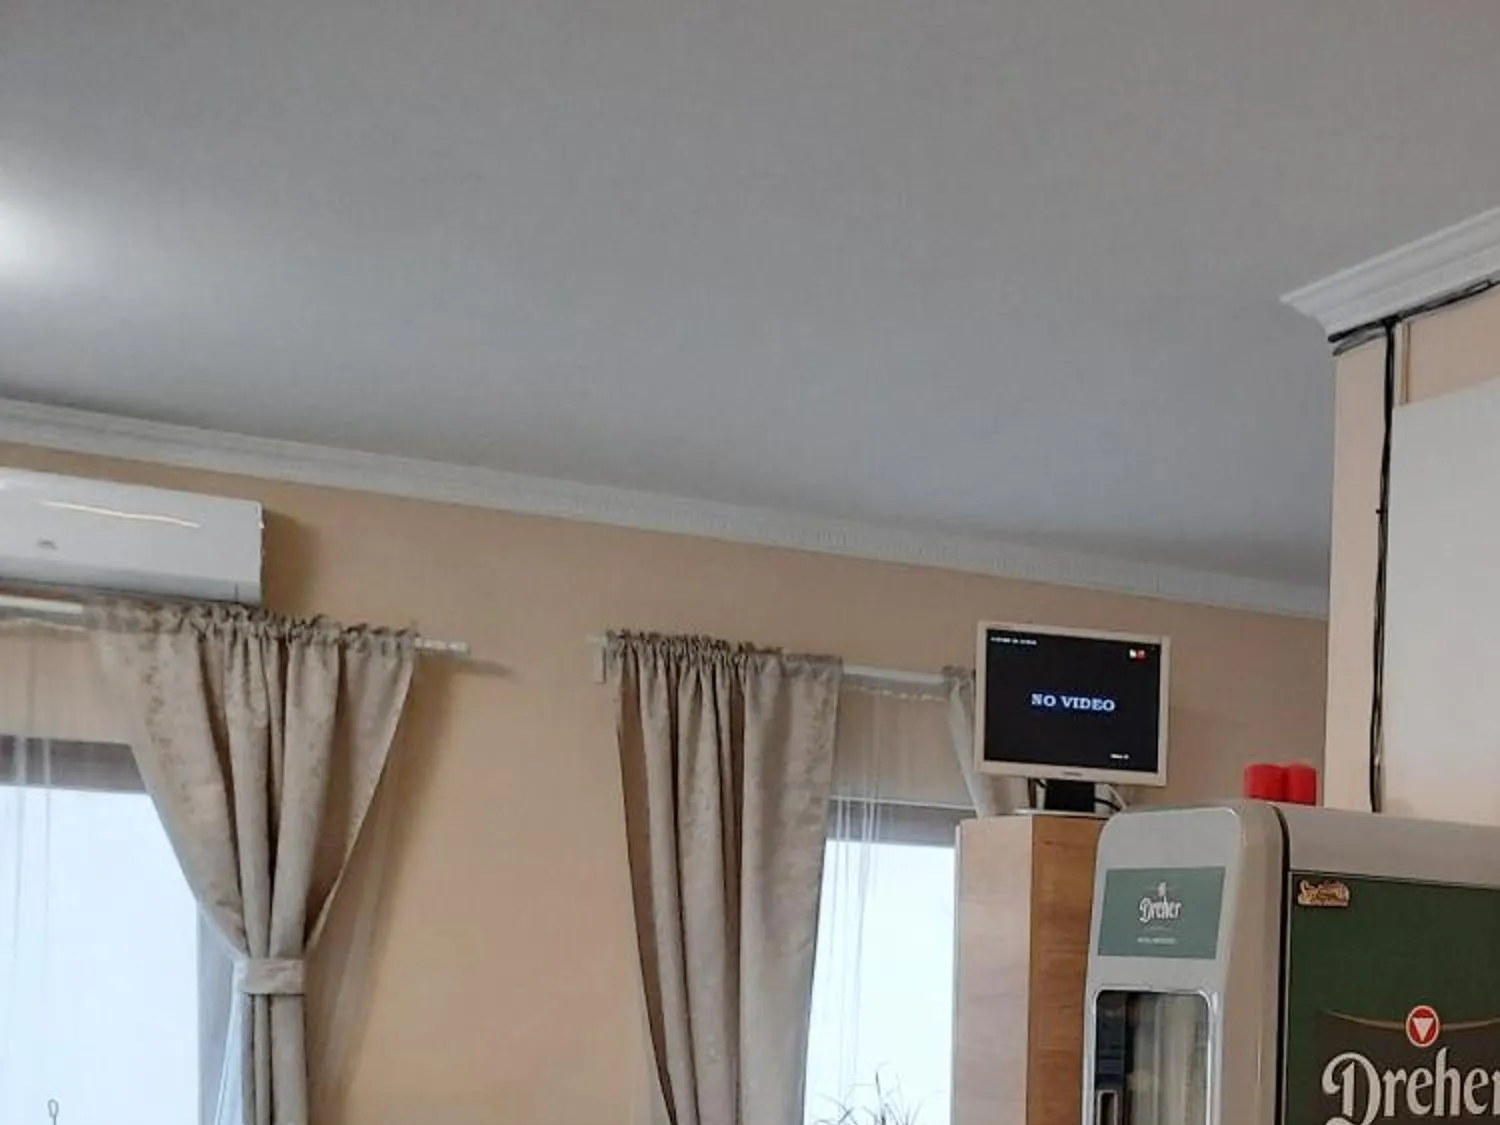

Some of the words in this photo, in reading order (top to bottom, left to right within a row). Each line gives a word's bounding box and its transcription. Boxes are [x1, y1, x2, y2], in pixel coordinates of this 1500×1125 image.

[1031, 693, 1057, 707] NO
[1061, 696, 1116, 712] VIDEO
[1139, 896, 1182, 923] Dreher
